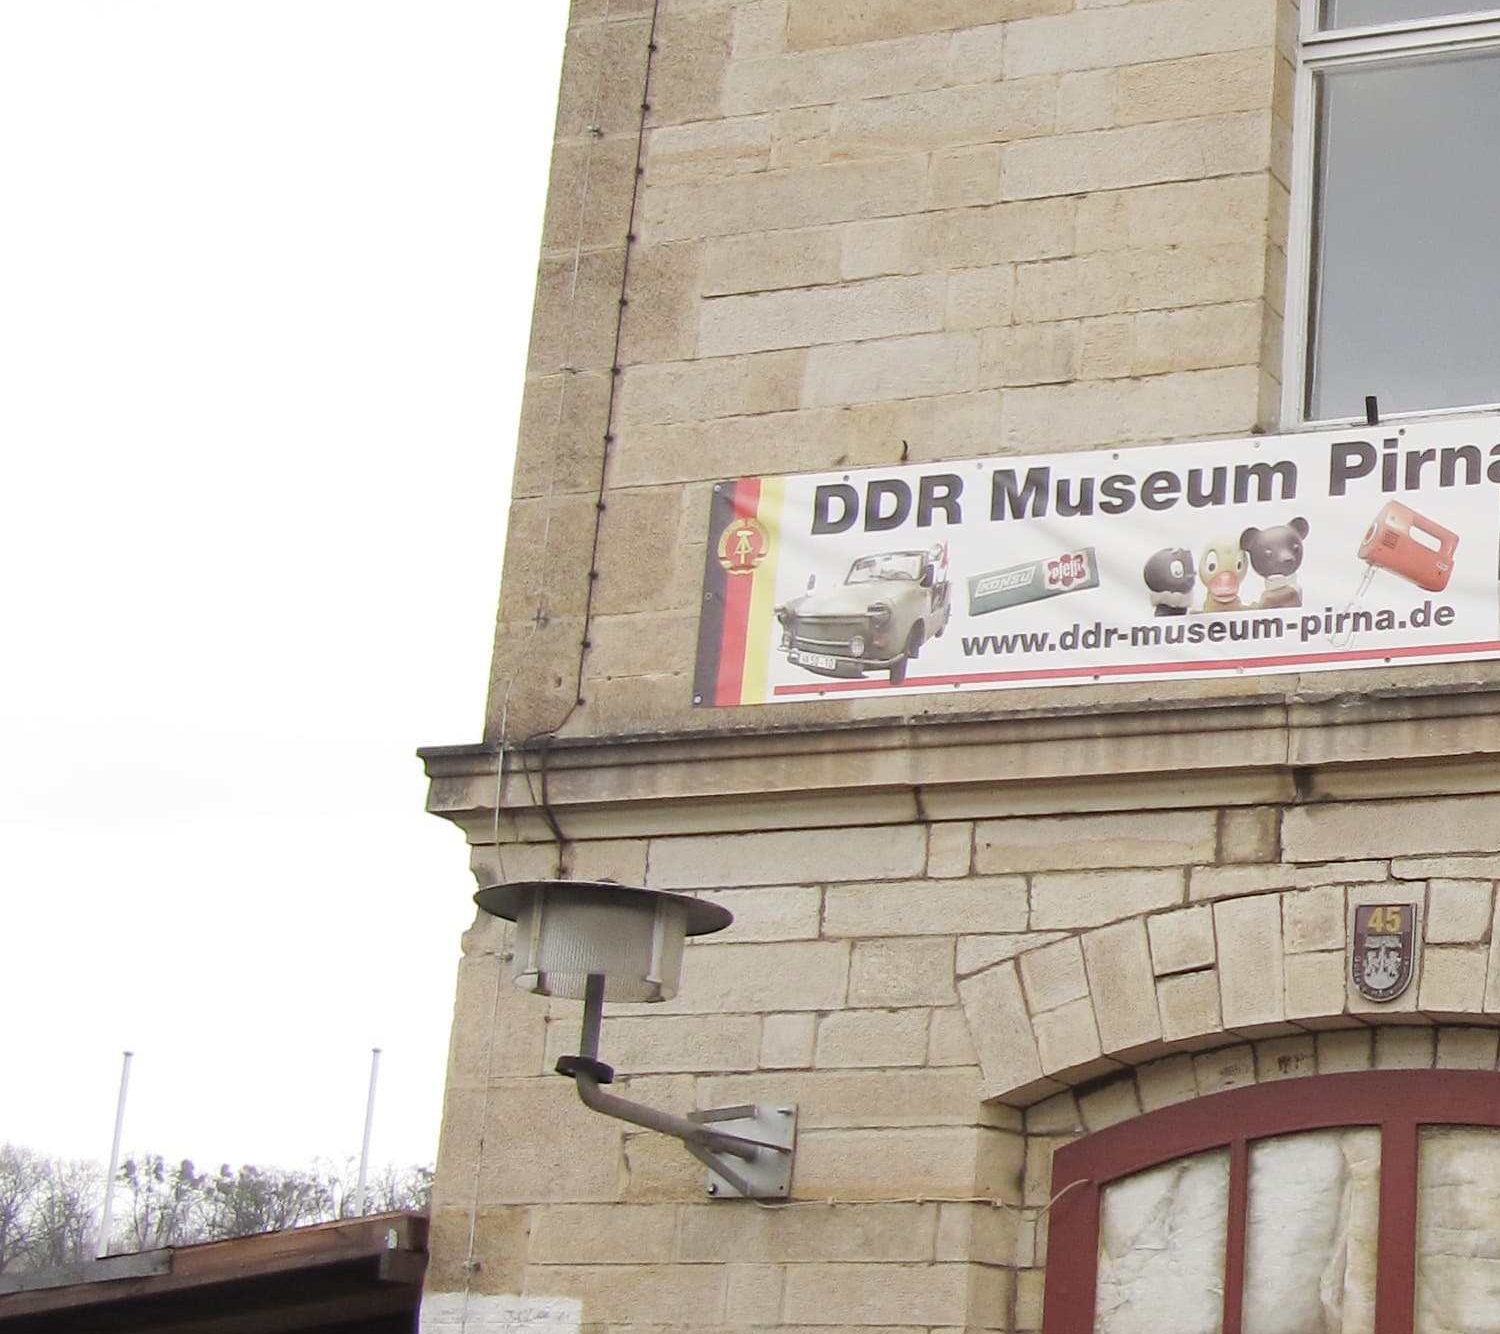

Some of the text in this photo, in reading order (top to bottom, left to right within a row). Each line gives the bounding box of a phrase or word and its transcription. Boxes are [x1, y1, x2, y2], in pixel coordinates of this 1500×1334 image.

[811, 473, 964, 536] DDR
[990, 459, 1298, 522] Museum
[961, 600, 1456, 656] www.ddr-museum-pirna.de
[1367, 906, 1401, 933] 45
